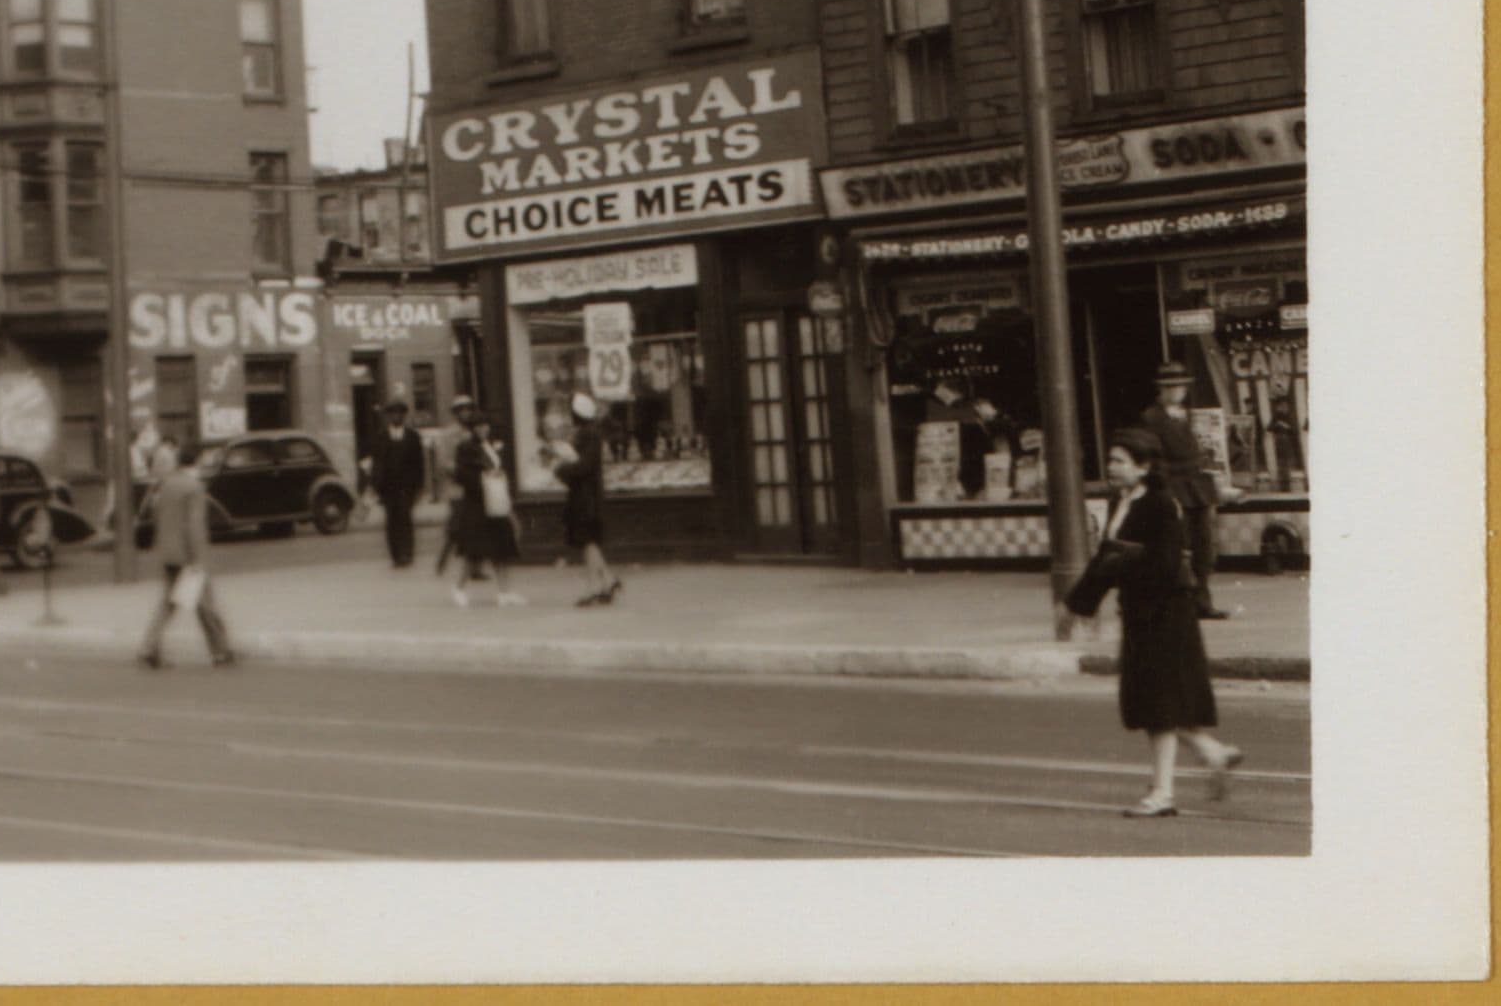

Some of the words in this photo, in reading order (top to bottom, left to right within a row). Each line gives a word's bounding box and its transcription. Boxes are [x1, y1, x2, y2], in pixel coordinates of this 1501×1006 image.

[441, 67, 802, 162] CRYSTAL
[479, 122, 762, 194] MARKETS
[1152, 127, 1247, 170] SODA
[464, 191, 621, 239] CHOICE
[634, 169, 785, 218] MEATS
[1105, 219, 1166, 240] CANDY
[128, 292, 317, 349] SIGNS
[333, 303, 367, 327] ICE
[385, 302, 443, 326] COAL
